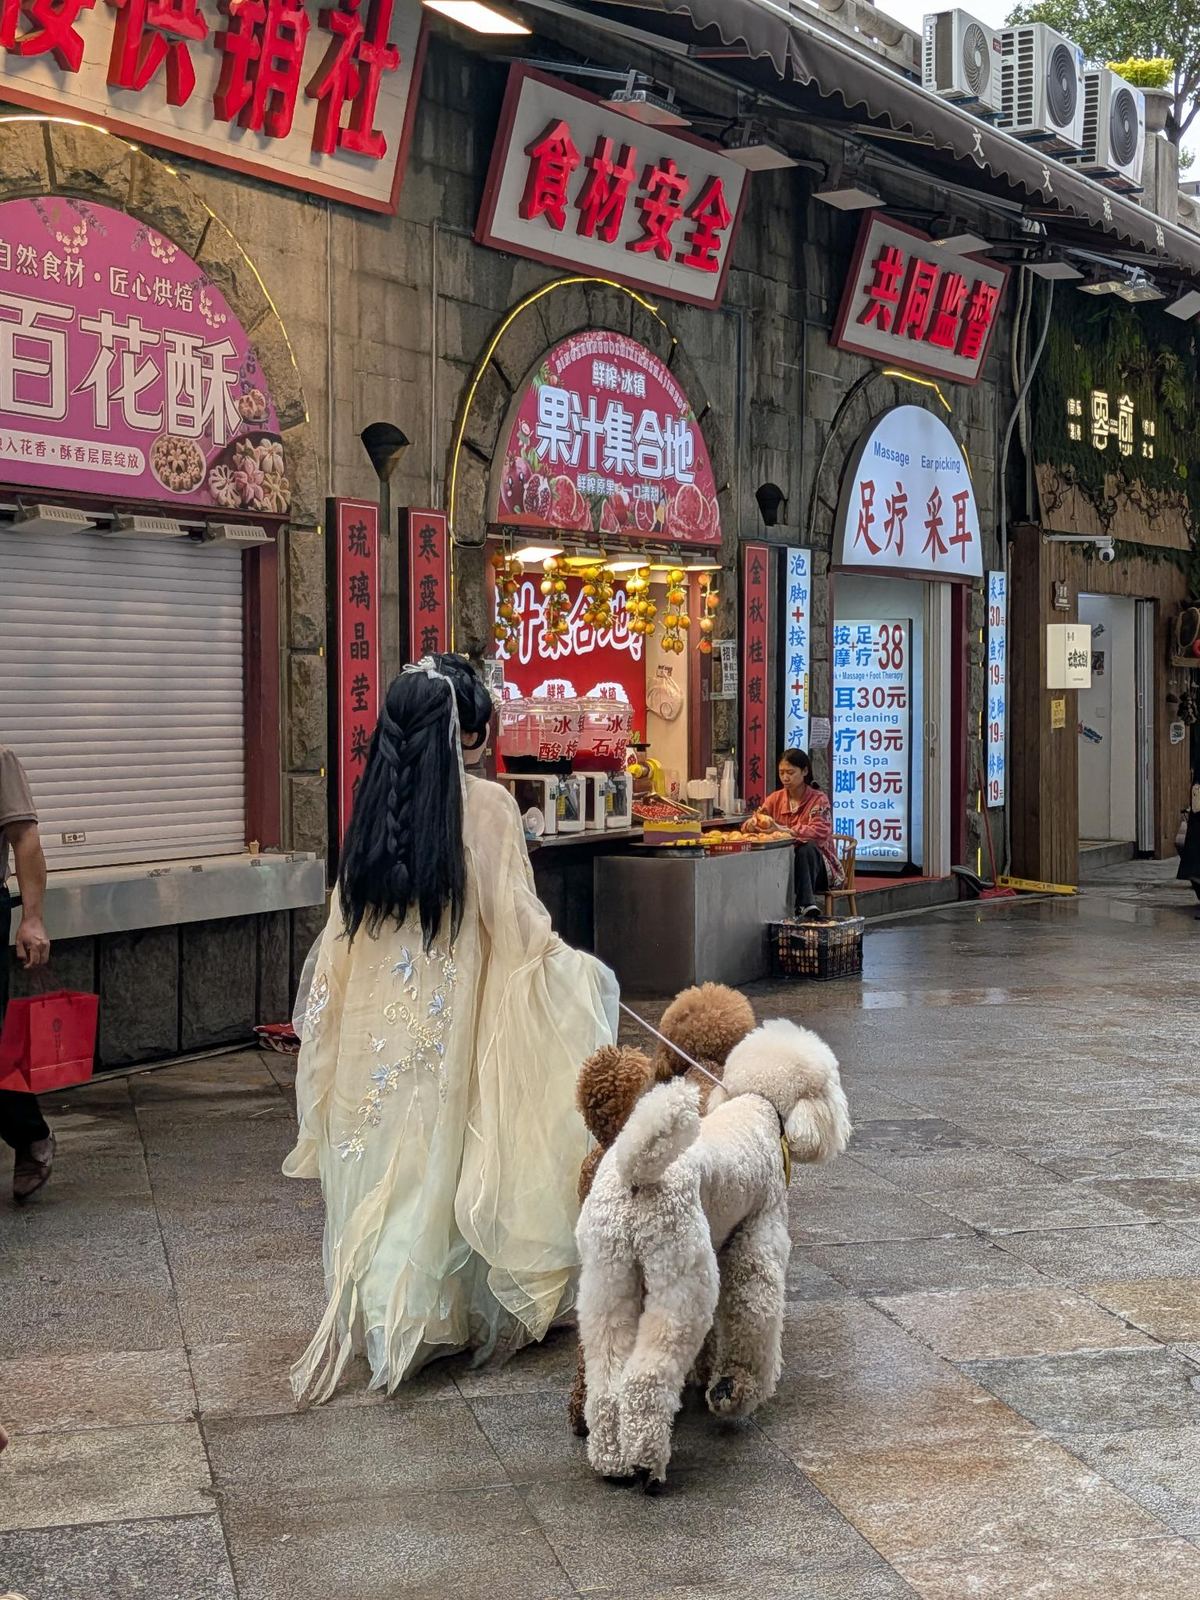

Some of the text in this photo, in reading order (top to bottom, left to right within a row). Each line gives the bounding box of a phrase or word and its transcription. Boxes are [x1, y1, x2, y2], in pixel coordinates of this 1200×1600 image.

[518, 118, 733, 273] 食材安全
[857, 246, 999, 360] 共同监督
[0, 293, 244, 447] 百花酥
[536, 383, 695, 484] 果汁集合地
[873, 441, 910, 468] Massage
[853, 479, 973, 564] 足疗 采耳
[834, 625, 851, 668] 按摩
[856, 625, 873, 667] 足疗
[842, 671, 865, 681] Massage
[869, 671, 881, 680] Foot
[882, 671, 904, 681] Therapy
[845, 712, 899, 725] cleaning
[863, 754, 889, 768] Spa
[861, 798, 896, 810] Soak
